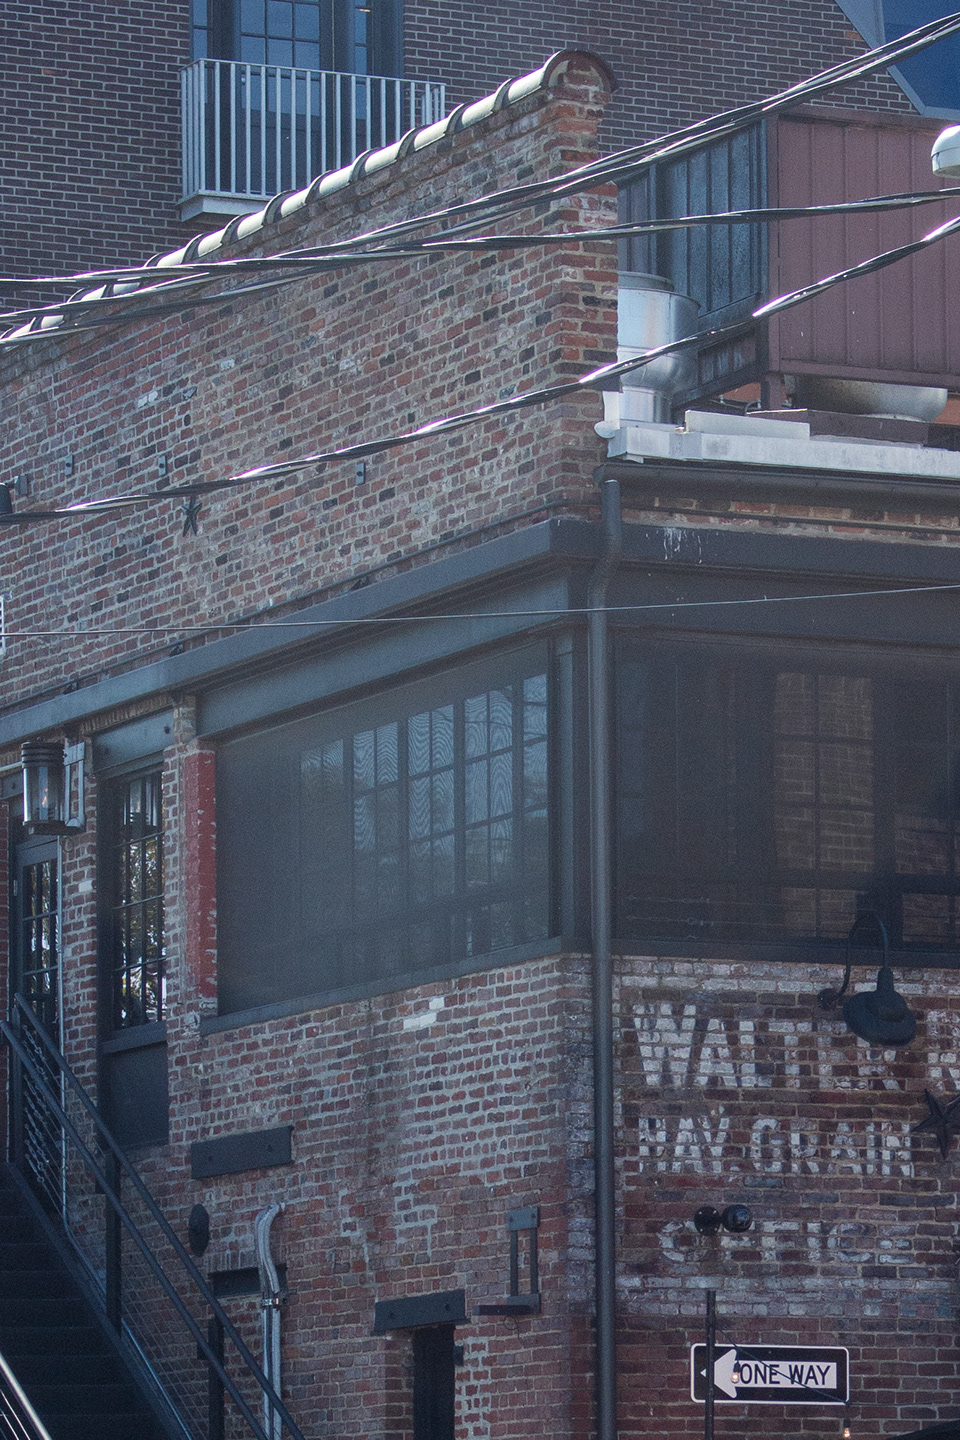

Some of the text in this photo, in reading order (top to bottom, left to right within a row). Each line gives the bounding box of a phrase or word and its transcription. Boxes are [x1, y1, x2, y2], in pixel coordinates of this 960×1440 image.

[632, 1003, 901, 1090] WALTER
[740, 1363, 831, 1386] ONE WAY
